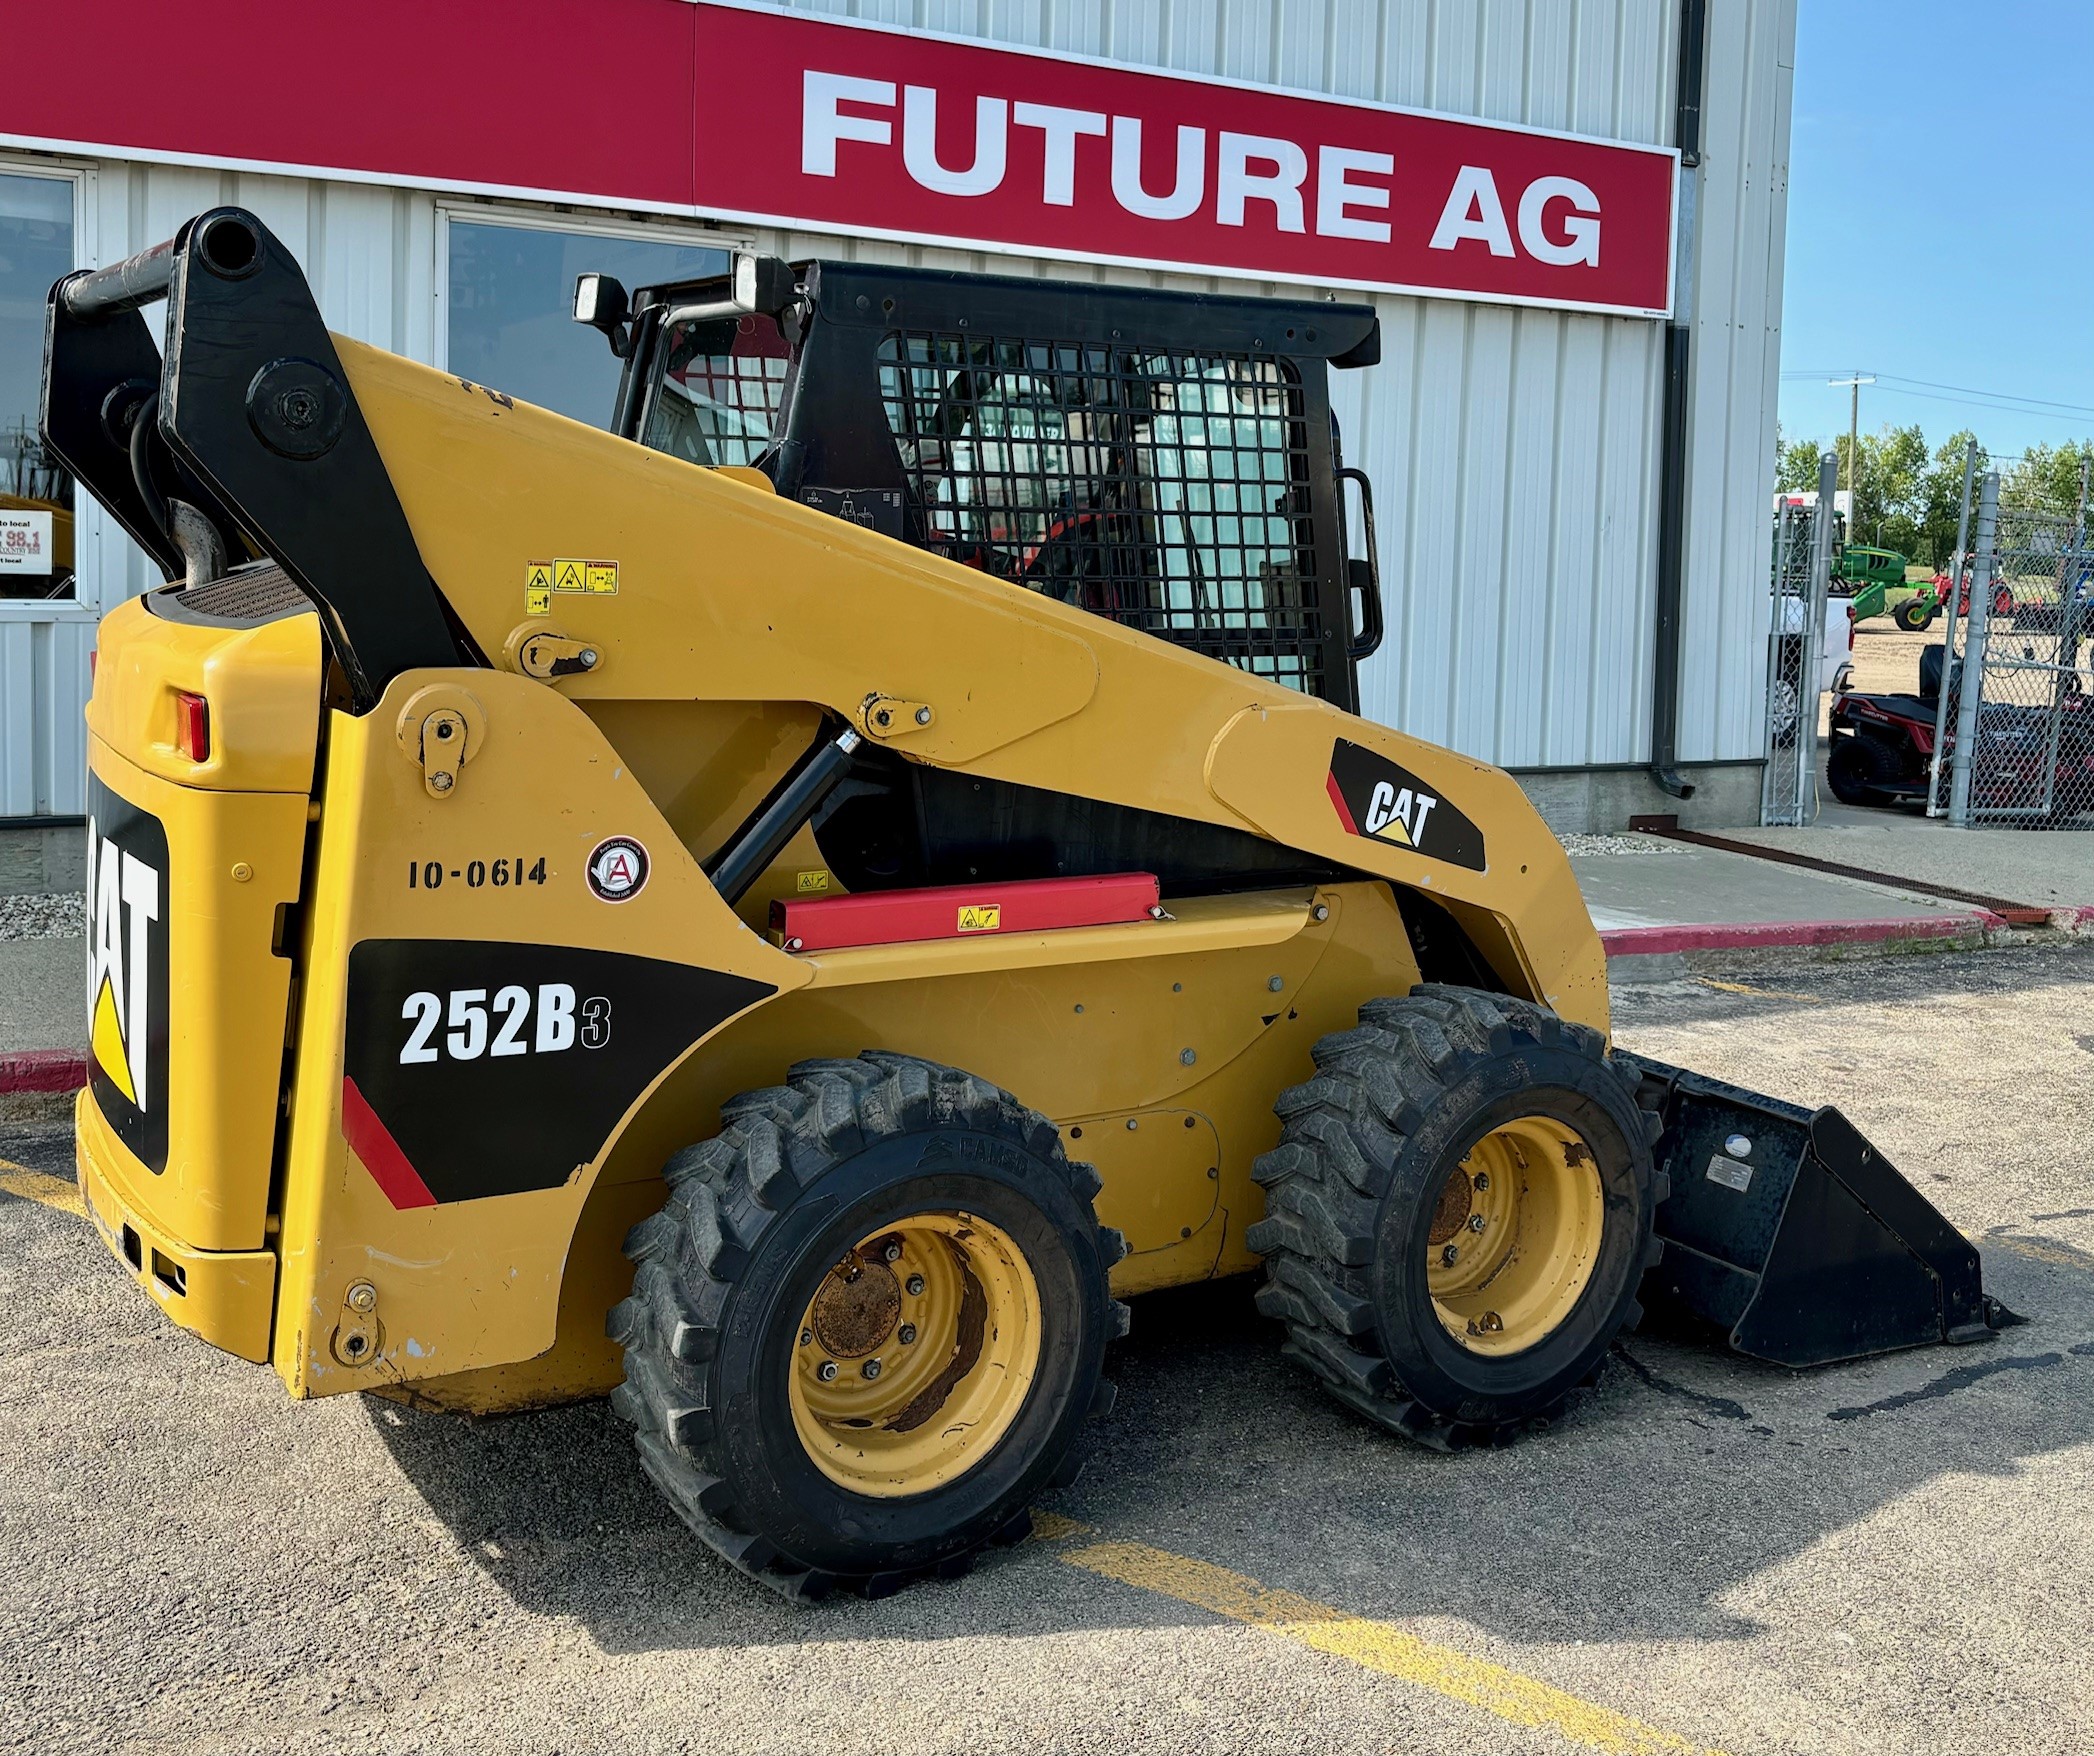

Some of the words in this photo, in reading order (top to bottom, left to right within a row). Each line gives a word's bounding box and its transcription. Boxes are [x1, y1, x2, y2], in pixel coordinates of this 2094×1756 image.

[802, 69, 1395, 244] FUTURE
[1428, 165, 1602, 268] AG
[10, 520, 30, 528] local
[1365, 781, 1437, 848] CAT
[409, 857, 547, 889] 10-0614
[87, 815, 159, 1113] CAT
